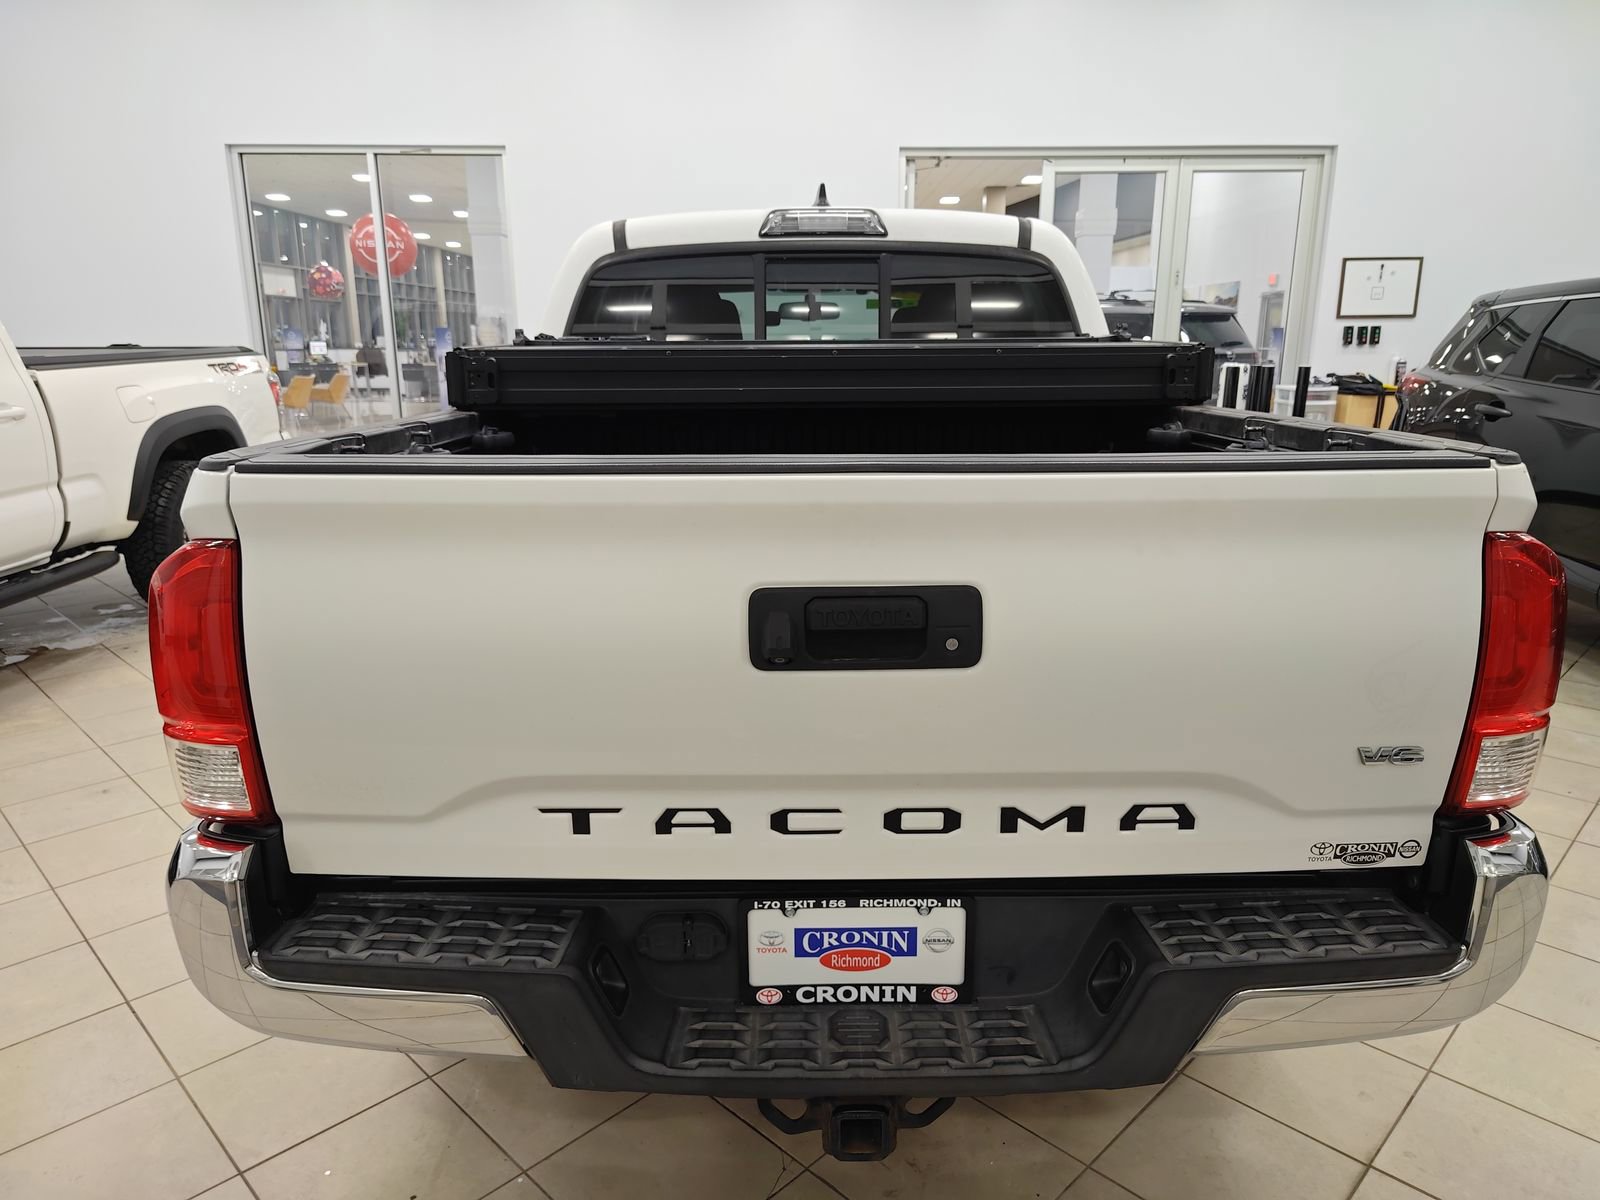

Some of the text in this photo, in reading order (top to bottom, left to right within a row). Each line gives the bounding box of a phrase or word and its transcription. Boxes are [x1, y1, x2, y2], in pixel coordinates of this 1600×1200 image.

[355, 239, 405, 250] NISAN
[816, 607, 920, 627] TOYOTA
[1357, 745, 1425, 766] V6
[537, 803, 1197, 835] TACOMA
[1335, 842, 1421, 856] CRONIN NISSAN
[1345, 854, 1384, 864] RICHMOND
[754, 900, 781, 910] I-70
[784, 900, 816, 909] EXIT
[821, 899, 847, 909] 156
[946, 898, 962, 907] IN
[756, 946, 788, 955] TOYOTA
[802, 930, 910, 954] CRONIN
[831, 953, 881, 968] Richmond
[795, 985, 917, 1004] CRONIN
